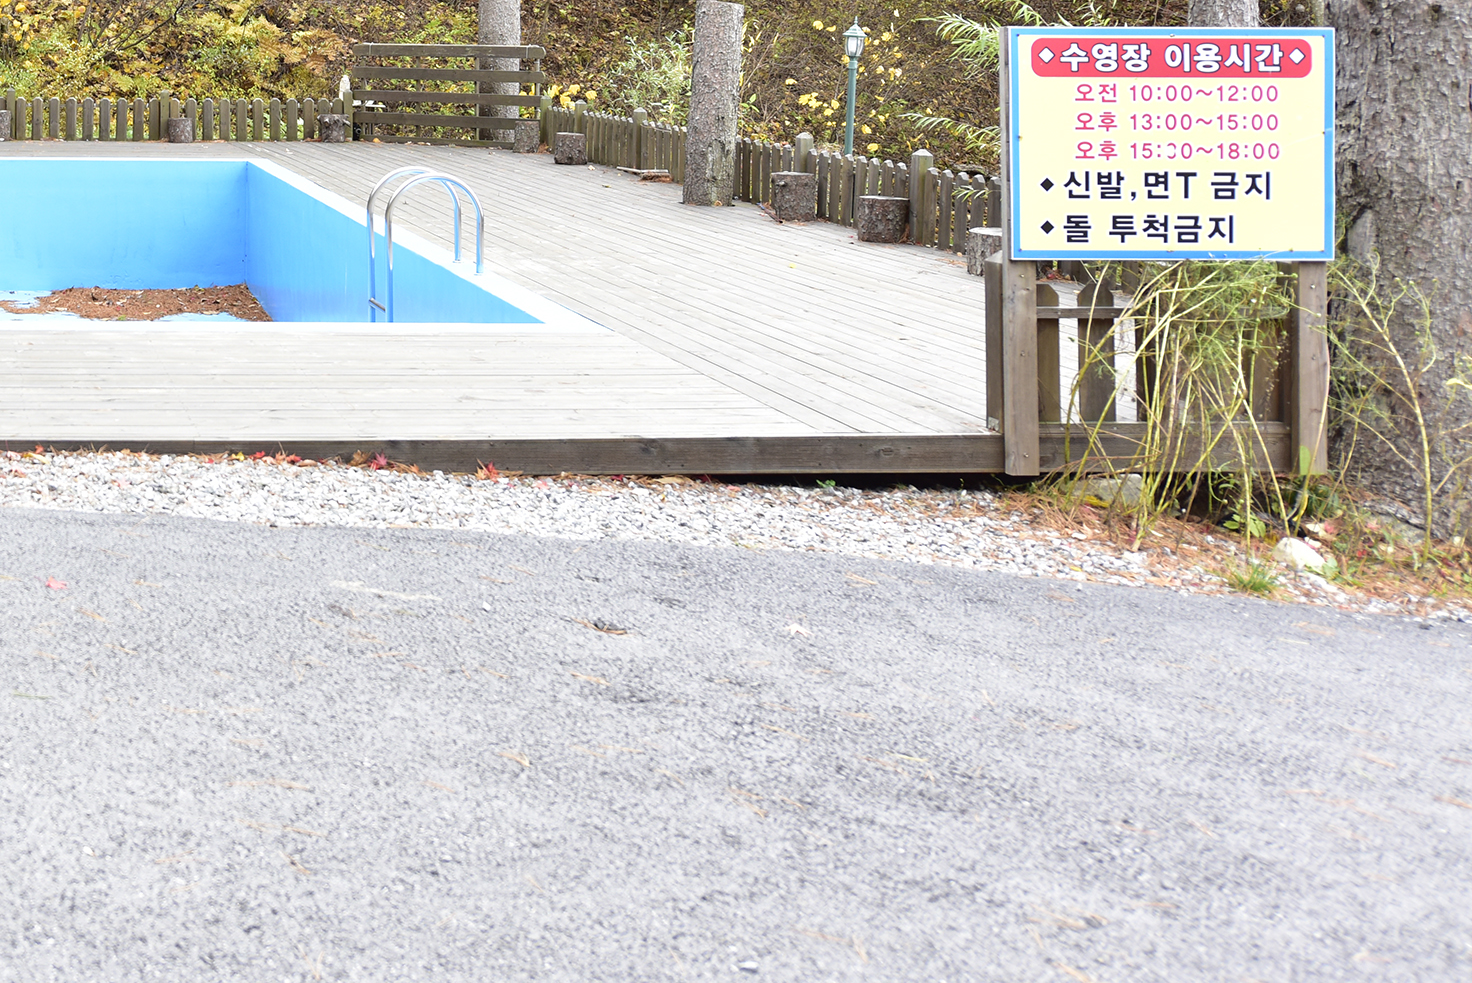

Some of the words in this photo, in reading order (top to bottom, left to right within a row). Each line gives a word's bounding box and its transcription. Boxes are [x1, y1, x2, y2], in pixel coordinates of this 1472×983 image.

[1059, 43, 1150, 73] 수영장
[1164, 43, 1283, 73] 이용시간
[1075, 84, 1118, 103] 오전
[1075, 112, 1118, 131] 오후
[1075, 141, 1118, 160] 오후
[1210, 171, 1271, 200] 금지
[1063, 215, 1091, 243] 돌
[1109, 215, 1235, 243] 투척금지
